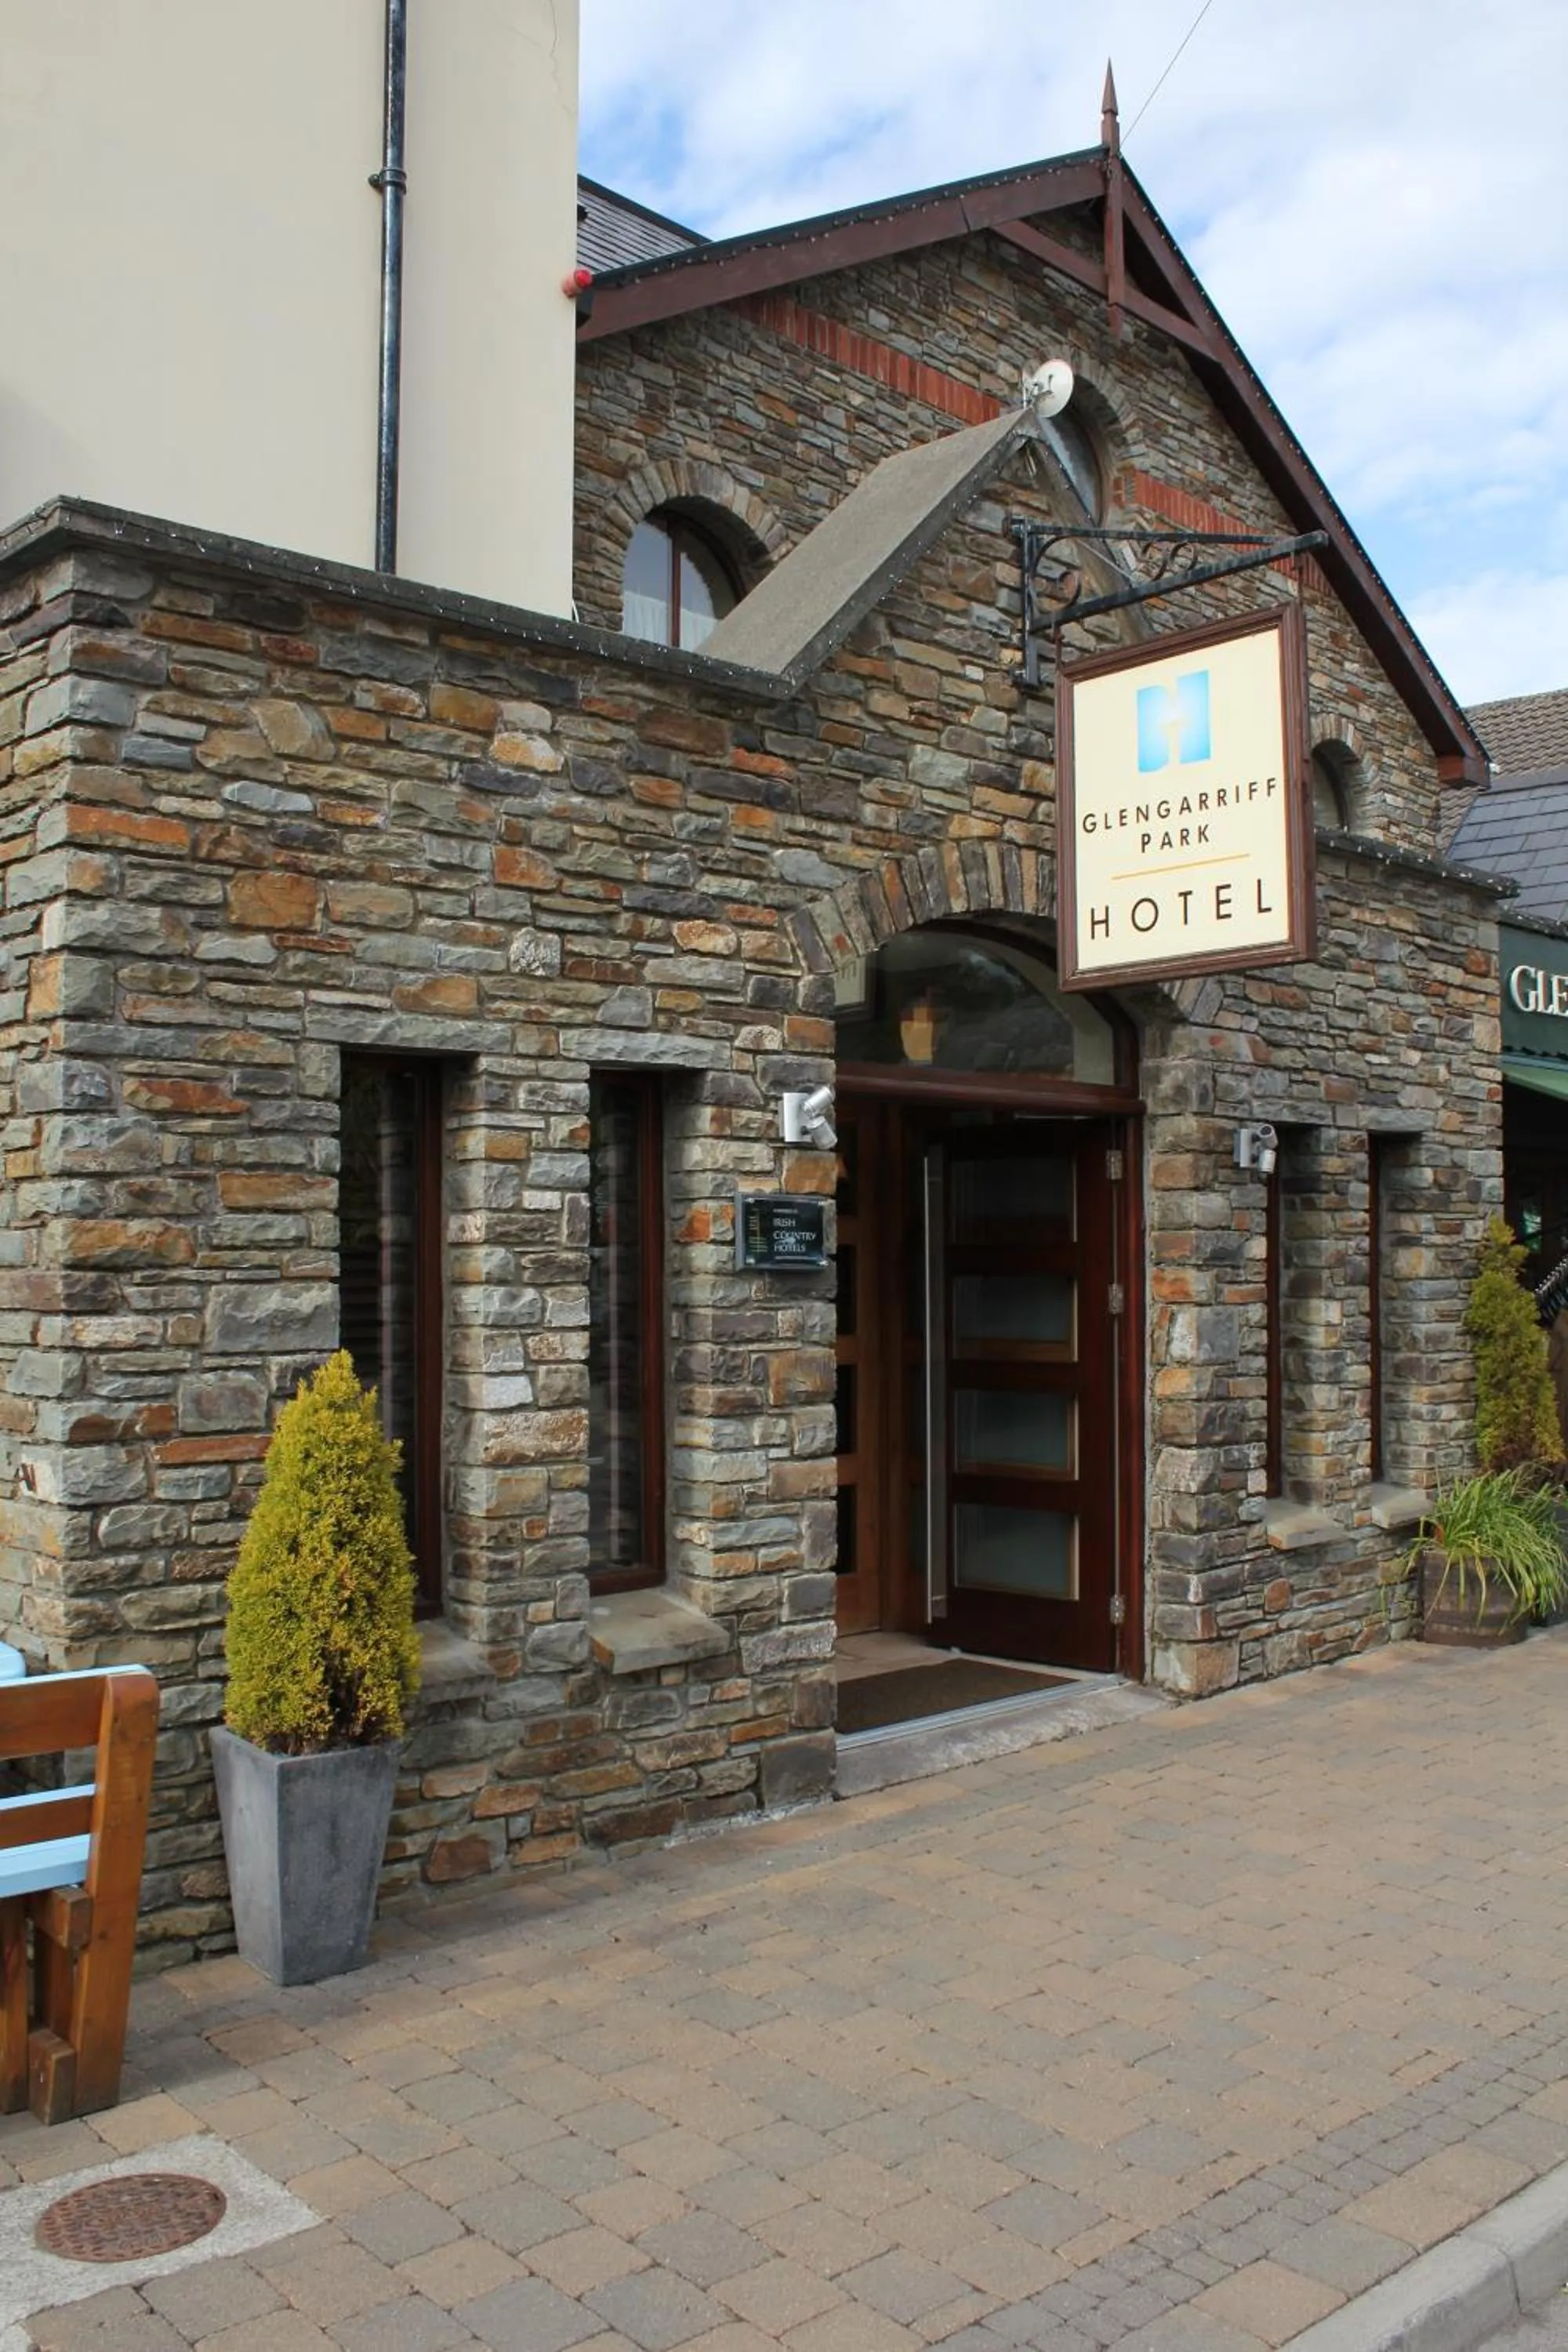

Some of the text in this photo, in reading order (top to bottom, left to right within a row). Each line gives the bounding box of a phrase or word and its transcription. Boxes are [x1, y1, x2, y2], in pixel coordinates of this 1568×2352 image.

[1083, 778, 1277, 833] GLENGARRIFF
[1141, 824, 1210, 854] PARK
[1091, 878, 1272, 940] HOTEL
[1510, 965, 1568, 1017] GLE
[773, 1231, 816, 1240] COUNTRY
